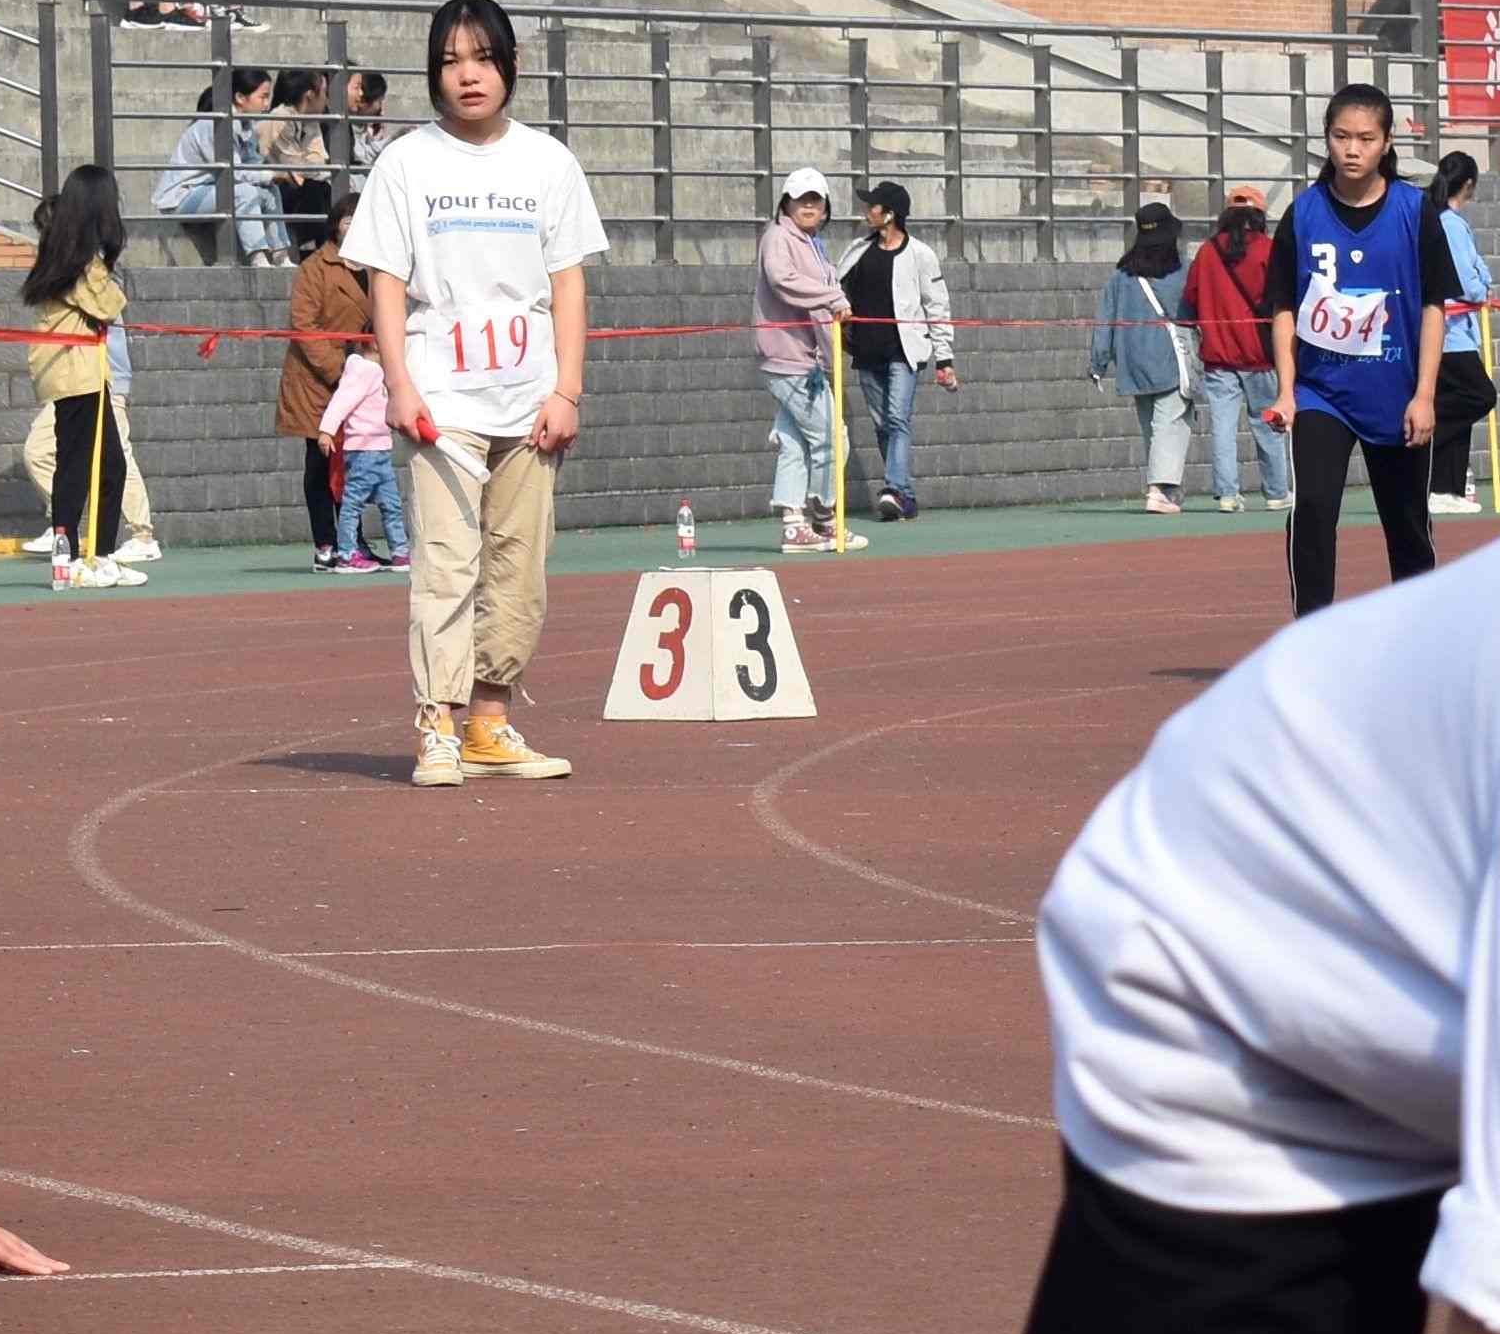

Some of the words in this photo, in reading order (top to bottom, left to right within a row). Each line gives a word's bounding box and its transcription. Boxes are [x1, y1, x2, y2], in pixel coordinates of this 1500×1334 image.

[425, 194, 479, 218] your
[486, 192, 537, 213] face
[447, 315, 528, 373] 119
[1310, 296, 1380, 343] 634
[639, 586, 693, 701] 3
[728, 587, 778, 703] 3
